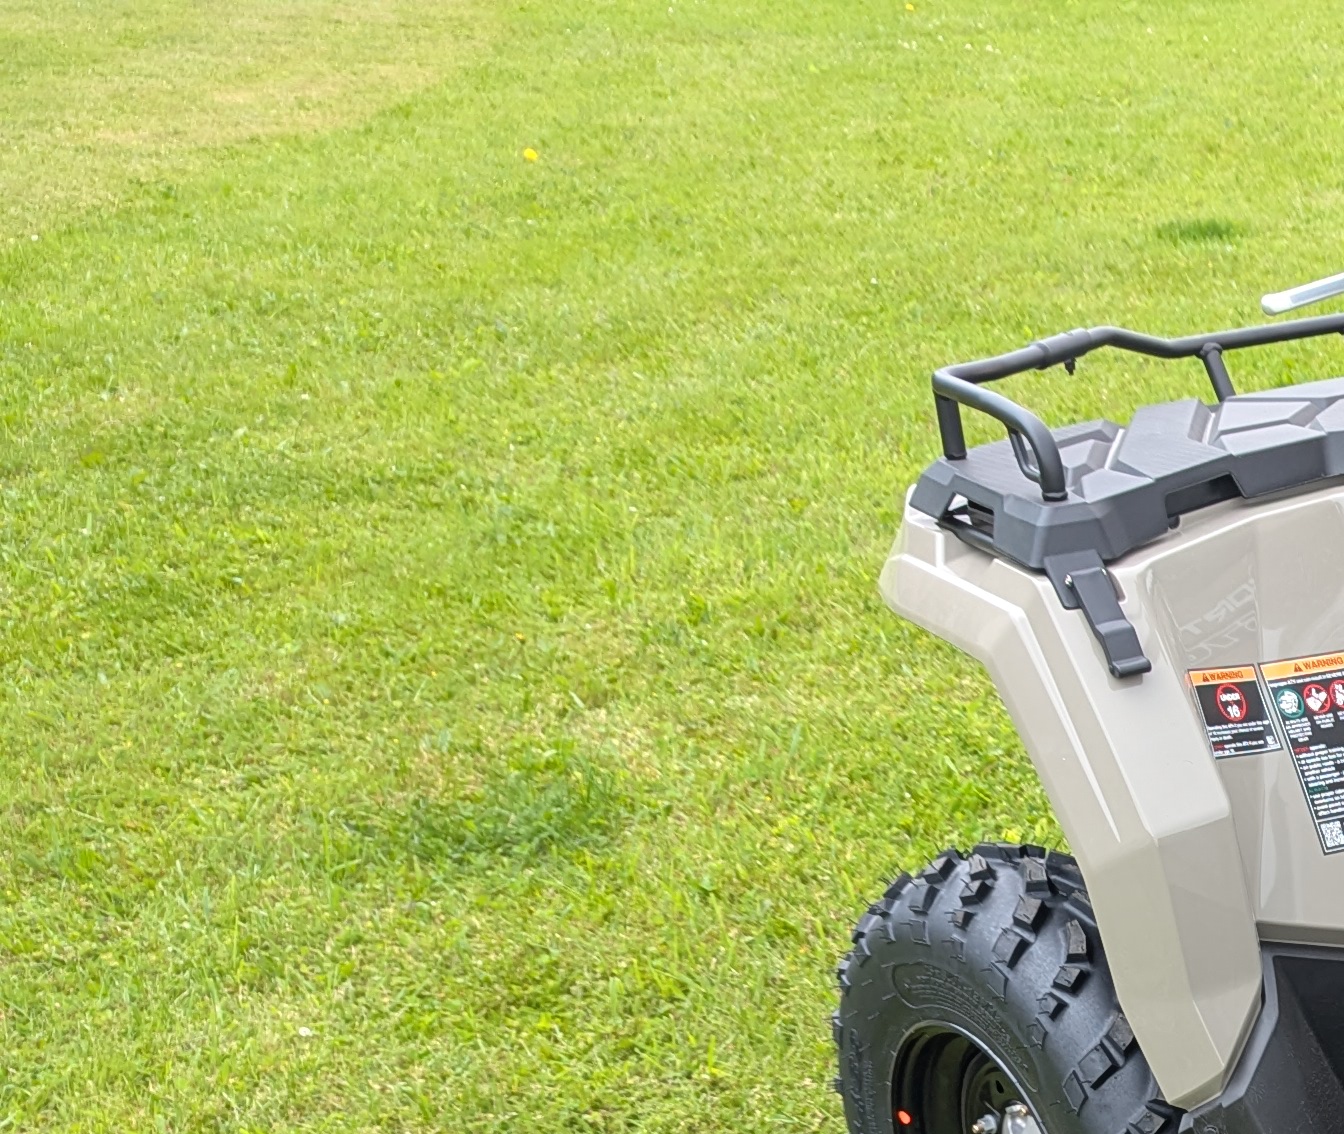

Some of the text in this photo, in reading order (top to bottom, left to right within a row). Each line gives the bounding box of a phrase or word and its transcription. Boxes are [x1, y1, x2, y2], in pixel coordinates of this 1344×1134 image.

[1302, 656, 1344, 671] WARNING
[1209, 670, 1244, 681] WARNING
[1226, 703, 1241, 718] 16
